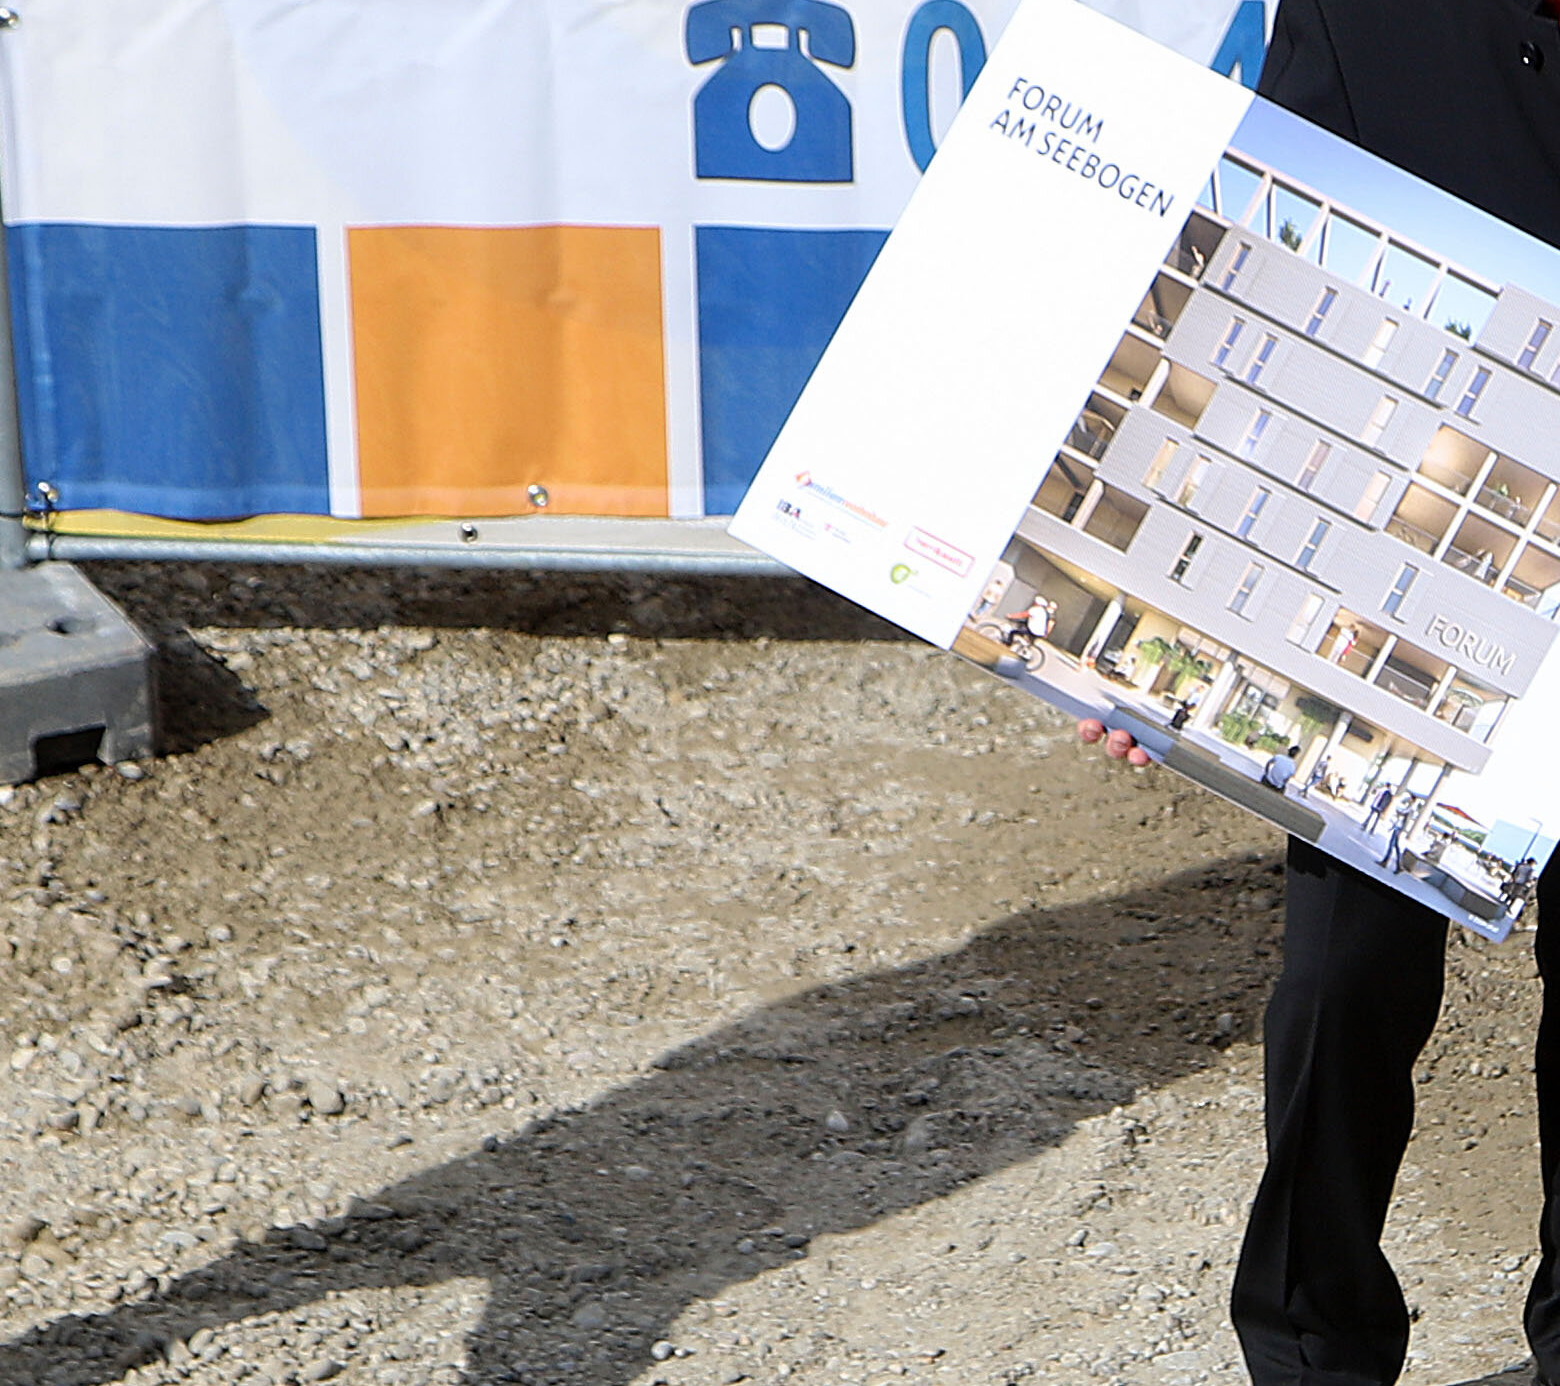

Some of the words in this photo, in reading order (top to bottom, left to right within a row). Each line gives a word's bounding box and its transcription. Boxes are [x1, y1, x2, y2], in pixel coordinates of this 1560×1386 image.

[1008, 76, 1107, 144] FORUM
[989, 108, 1037, 154] AM
[1035, 132, 1177, 219] SEEBOGEN
[1424, 613, 1520, 678] FORUM
